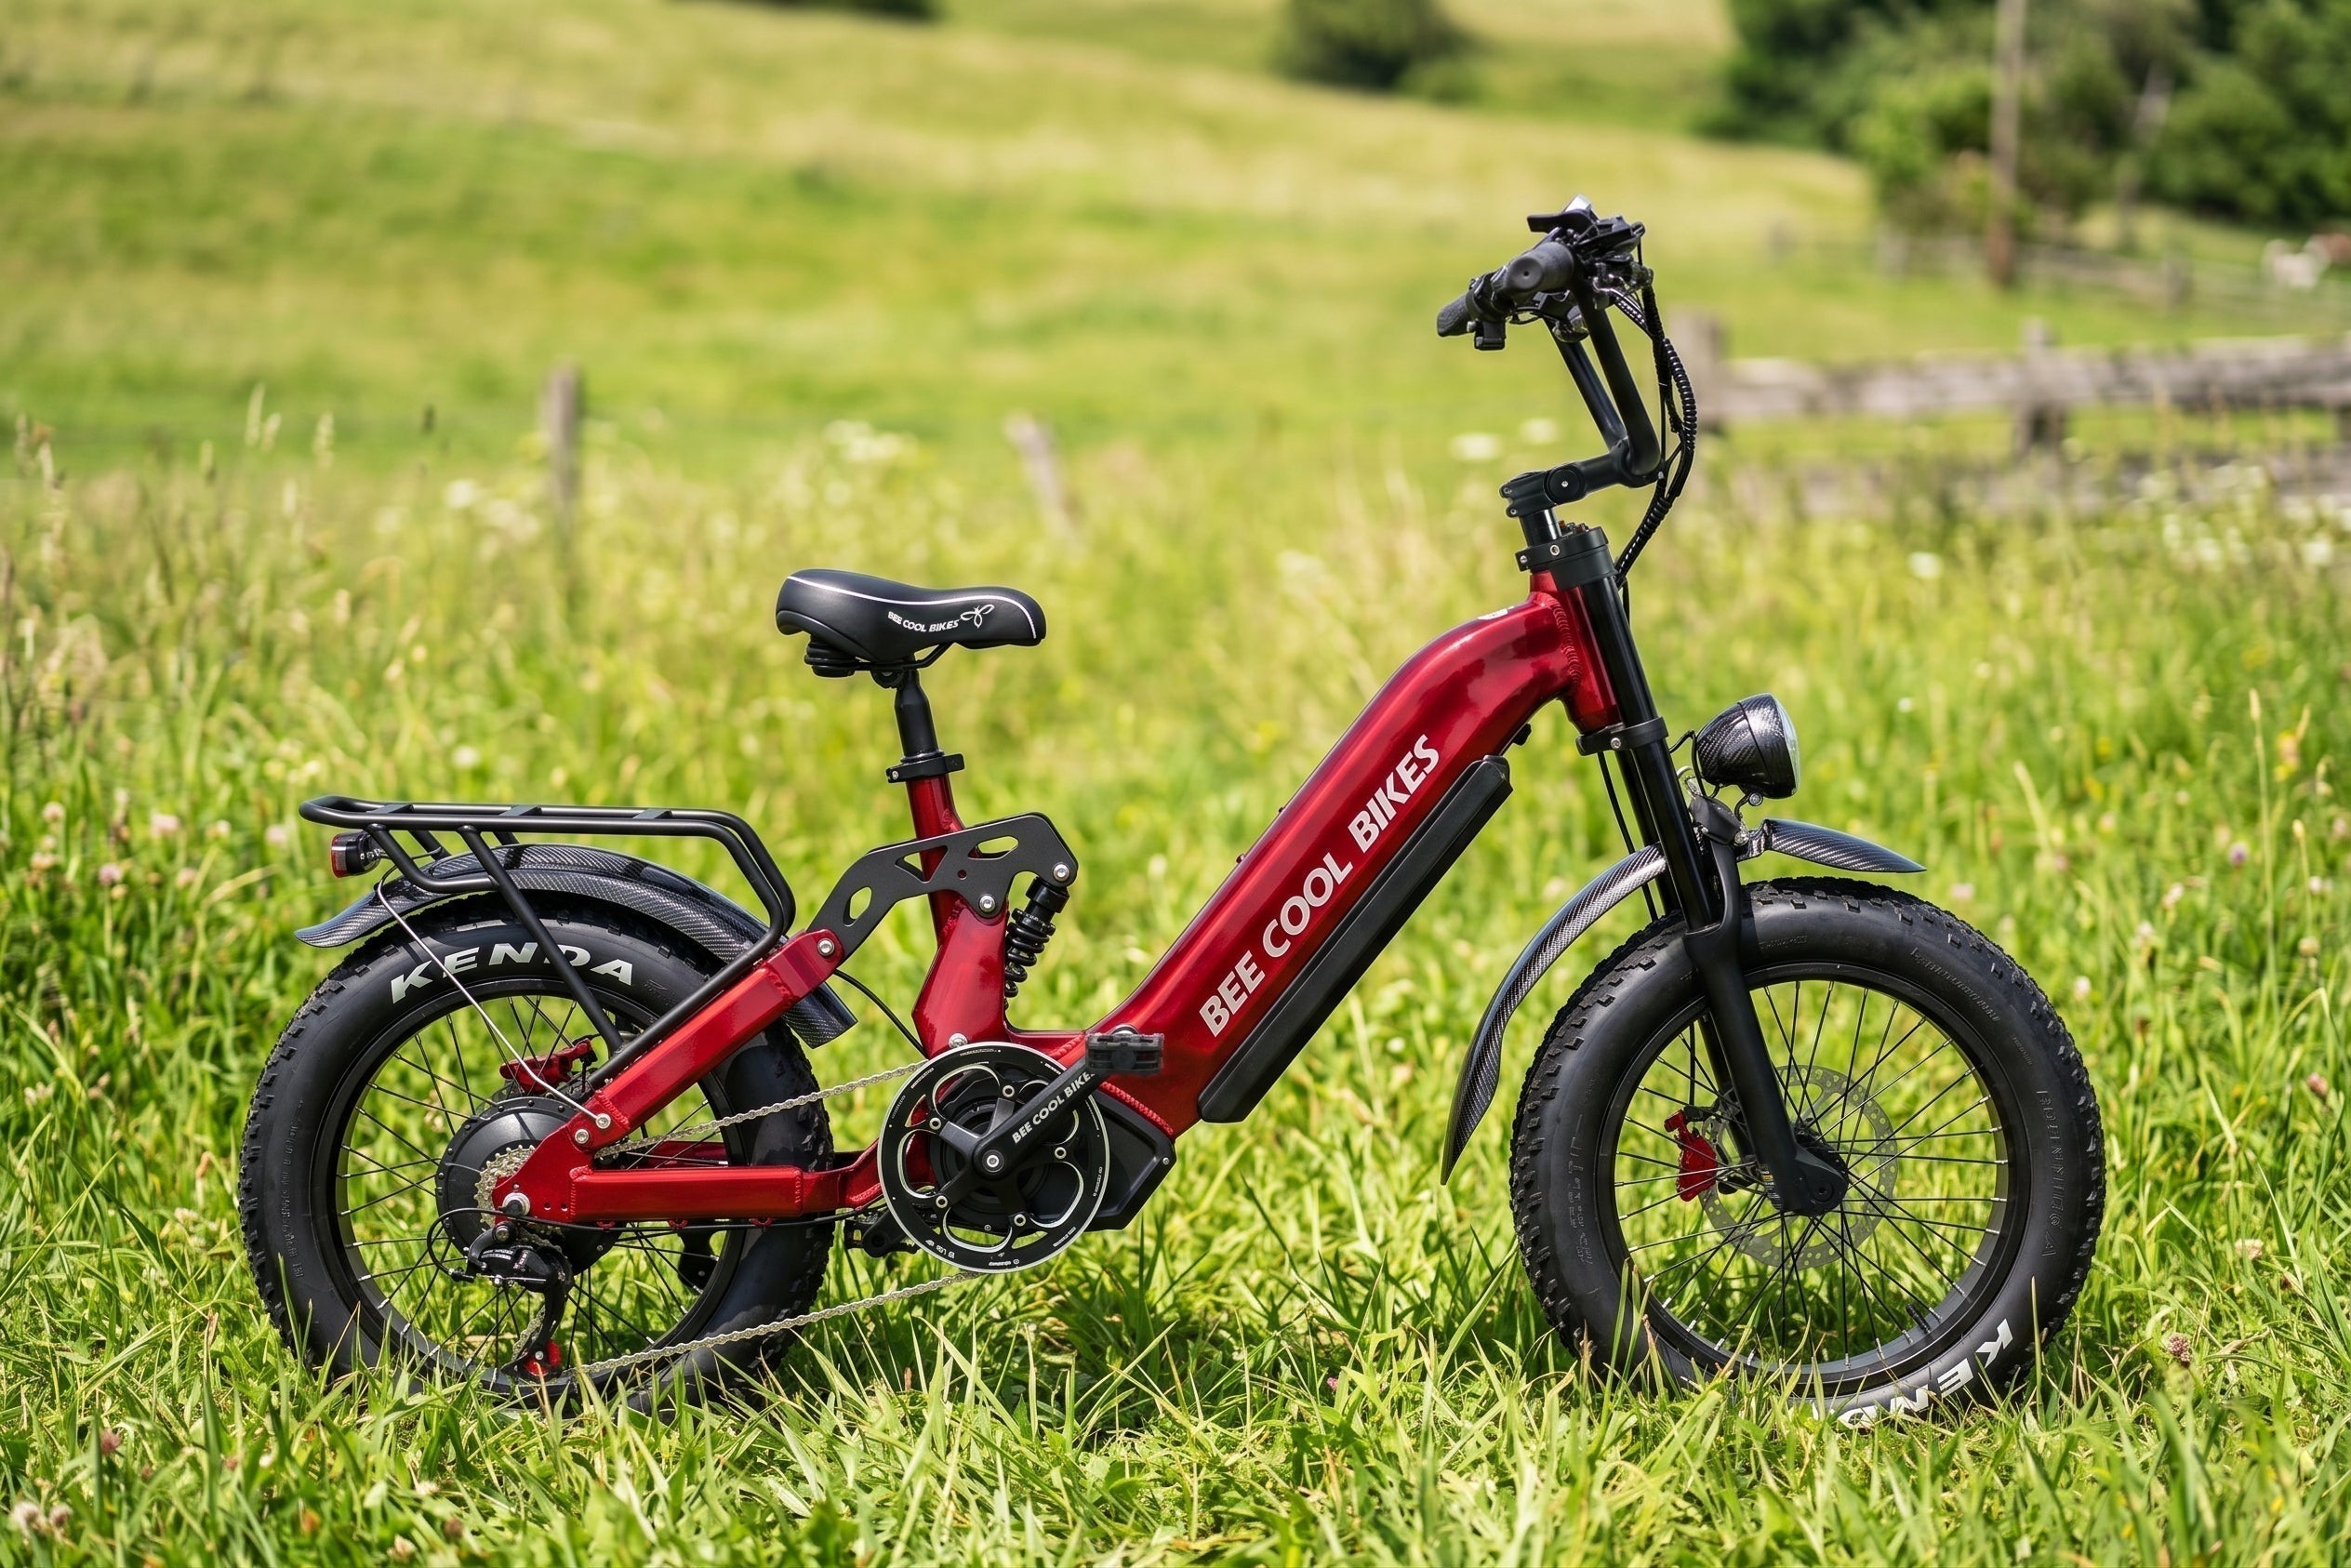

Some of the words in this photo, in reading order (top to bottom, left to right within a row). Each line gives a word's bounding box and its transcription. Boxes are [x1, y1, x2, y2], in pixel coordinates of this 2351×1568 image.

[888, 611, 903, 625] BEE
[903, 619, 926, 632] COOL
[929, 619, 960, 632] BIKES
[1199, 950, 1266, 1037] BEE
[1262, 852, 1353, 958] COOL
[1348, 734, 1440, 853] BIKES
[392, 941, 633, 1003] KENDA
[1012, 1122, 1032, 1144] BEE
[1032, 1096, 1065, 1125] COOL
[1063, 1071, 1096, 1097] BIKE
[1787, 1318, 2013, 1429] KEND
